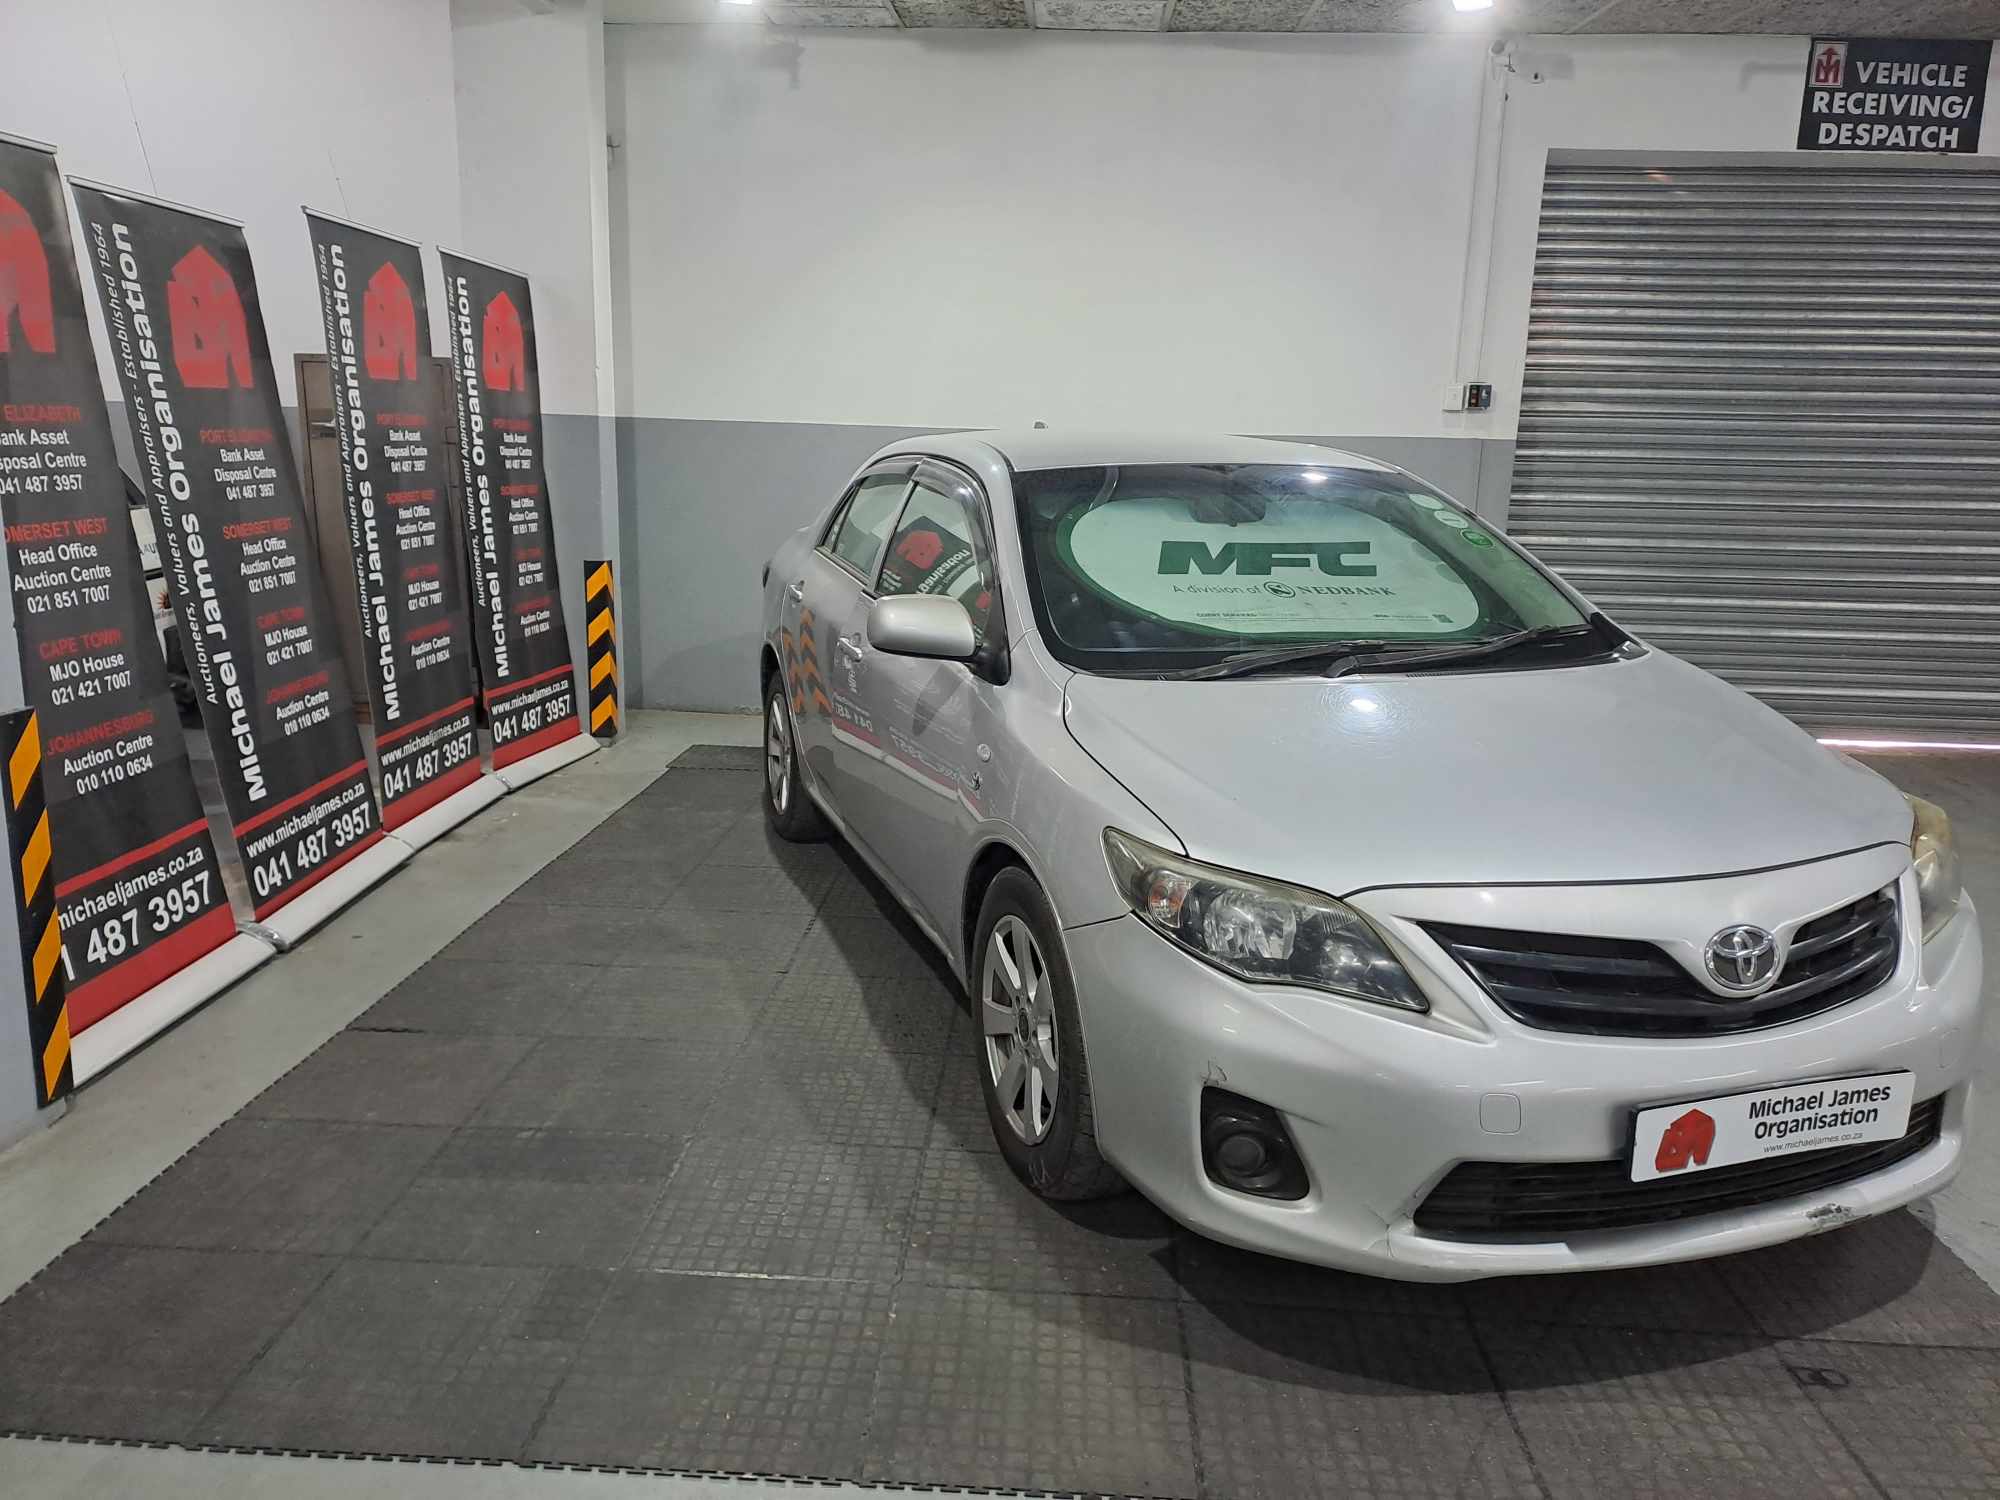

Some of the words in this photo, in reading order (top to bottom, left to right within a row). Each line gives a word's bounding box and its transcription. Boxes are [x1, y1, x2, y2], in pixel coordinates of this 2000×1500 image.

[1856, 61, 1968, 87] VEHICLE
[1812, 91, 1974, 119] RECEIVING/
[1818, 122, 1959, 149] DESPATCH
[91, 221, 112, 269] 1964
[102, 272, 138, 380] Established
[112, 223, 191, 501] Organisation
[330, 243, 368, 471] Organisation
[456, 276, 485, 467] Organisation
[0, 429, 27, 446] ank
[30, 428, 70, 446] Asset
[335, 383, 350, 461] Appraisers
[134, 395, 165, 490] Appraisers
[220, 448, 242, 463] Bank
[0, 452, 42, 474] sposal
[45, 452, 87, 468] Centre
[214, 467, 251, 484] Disposal
[344, 463, 354, 492] and
[25, 475, 48, 493] 487
[53, 474, 82, 491] 3957
[226, 486, 241, 501] 041
[153, 493, 173, 528] and
[349, 495, 361, 548] Valuers
[477, 474, 497, 565] James
[4, 520, 70, 542] OMERSET
[242, 541, 263, 556] Head
[263, 537, 287, 551] Office
[359, 480, 384, 587] James
[18, 547, 55, 567] Head
[58, 542, 98, 561] Office
[166, 532, 190, 596] Valuers
[240, 559, 271, 576] Auction
[272, 554, 296, 570] Centre
[1157, 540, 1378, 577] MFC
[14, 568, 68, 592] Auction
[70, 564, 112, 585] Centre
[181, 513, 227, 641] James
[249, 578, 263, 593] 021
[263, 576, 278, 590] 851
[1172, 584, 1185, 593] A
[1187, 584, 1241, 594] division
[1246, 584, 1262, 594] of
[1297, 585, 1397, 596] NEDBANK
[27, 593, 51, 614] 021
[53, 590, 79, 608] 851
[83, 584, 110, 603] 7007
[281, 625, 308, 641] House
[485, 571, 510, 678] Michael
[39, 636, 76, 659] CAPE
[186, 602, 219, 704] Auctioneers,
[266, 650, 281, 666] 021
[280, 644, 295, 660] 421
[371, 595, 400, 721] Michael
[50, 661, 80, 682] MJO
[82, 654, 124, 674] House
[51, 685, 75, 706] 021
[78, 678, 101, 698] 421
[105, 670, 132, 692] 7007
[212, 650, 267, 802] Michael
[276, 699, 305, 720] Auction
[284, 720, 299, 736] 010
[298, 713, 312, 730] 110
[493, 715, 518, 743] 041
[521, 706, 542, 732] 487
[545, 694, 570, 722] 3957
[63, 746, 113, 776] Auction
[116, 733, 153, 756] Centre
[381, 715, 470, 767] www.michaeljames.co.za
[77, 774, 99, 795] 010
[100, 765, 124, 786] 110
[127, 754, 153, 776] 0634
[384, 763, 412, 799] 041
[415, 749, 439, 781] 487
[442, 732, 472, 767] 3957
[246, 782, 365, 858] www.michaeljames.co.za
[253, 850, 292, 896] 041
[297, 827, 328, 869] 487
[331, 801, 371, 847] 3957
[57, 847, 204, 930] michaeljames.co.za
[87, 908, 140, 964] 487
[148, 870, 210, 932] 3957
[1748, 1090, 1825, 1120] Michael
[1829, 1084, 1892, 1107] James
[1754, 1106, 1879, 1140] Organisation
[1763, 1131, 1864, 1154] www.michaeljames.co.za
